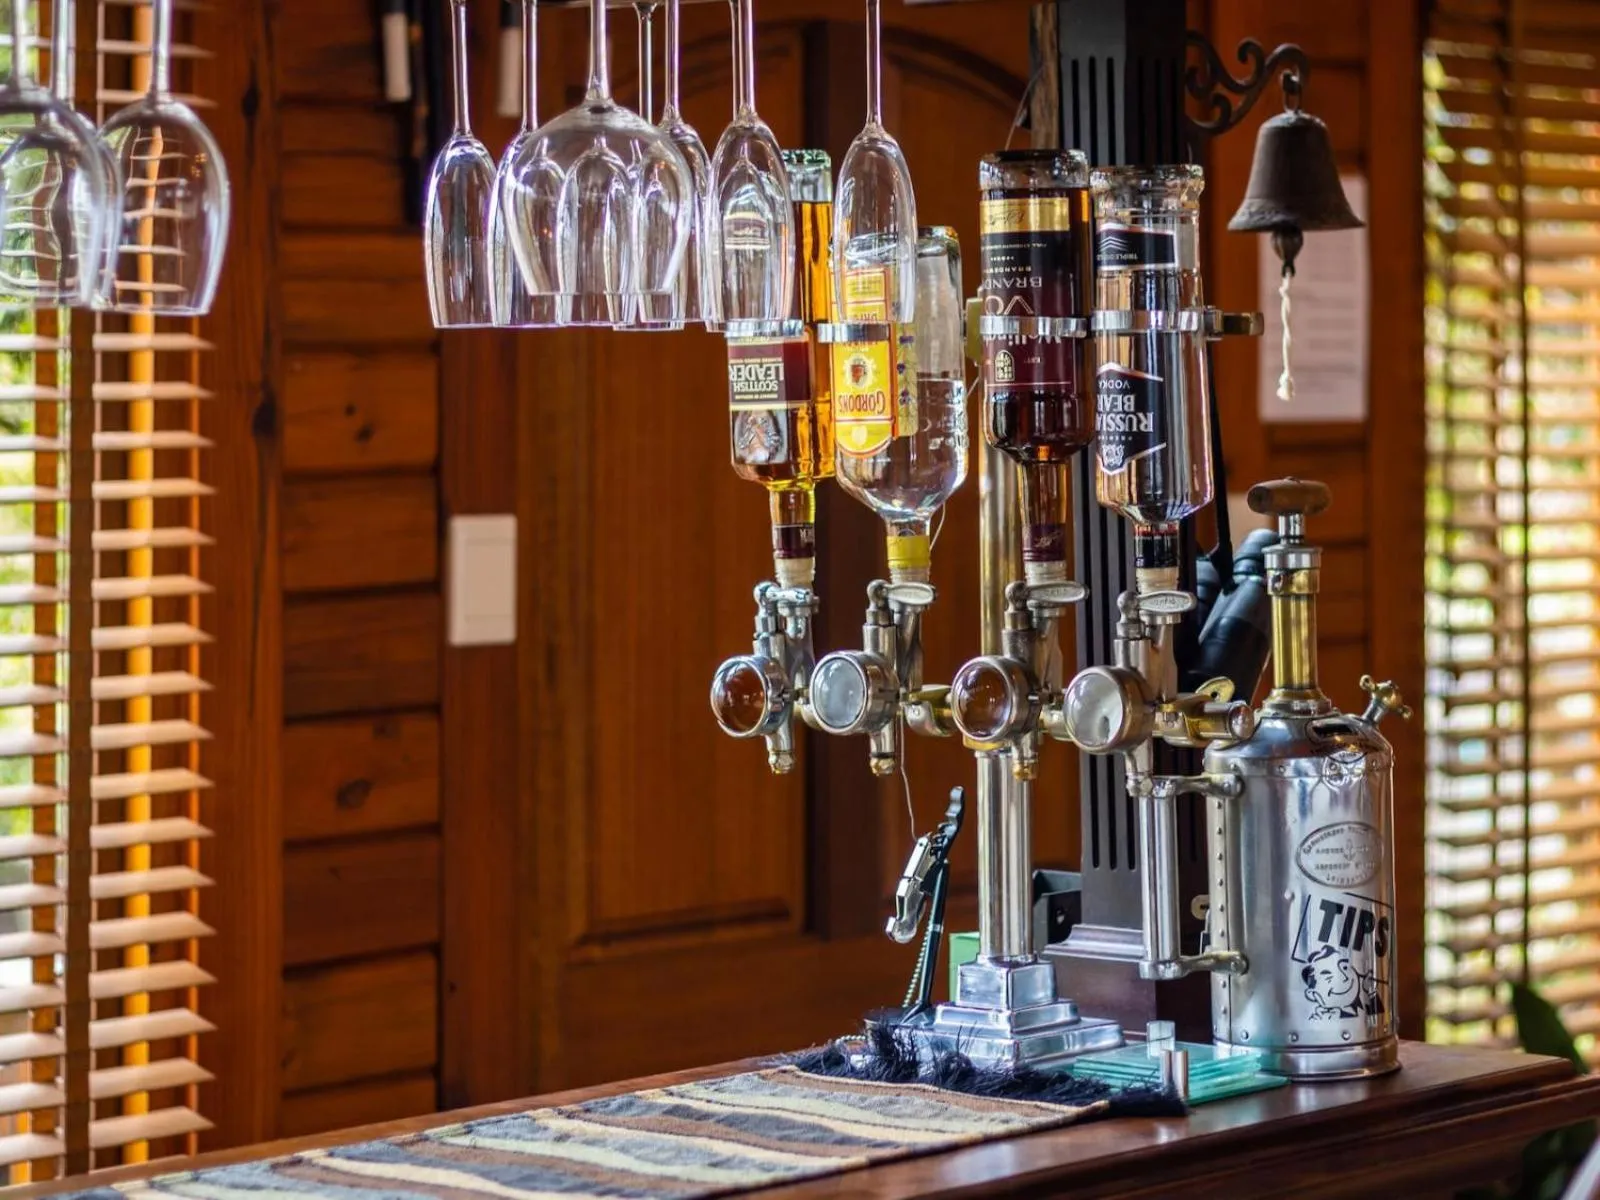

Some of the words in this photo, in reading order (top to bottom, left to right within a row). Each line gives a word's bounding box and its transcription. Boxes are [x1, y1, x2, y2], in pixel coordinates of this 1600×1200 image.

[728, 363, 785, 381] LEADER
[733, 380, 778, 393] SCOTTISH
[1098, 379, 1131, 389] VODKA
[1096, 394, 1136, 412] BEAR
[1095, 411, 1154, 433] RUSSIA
[1318, 898, 1389, 958] TIPS
